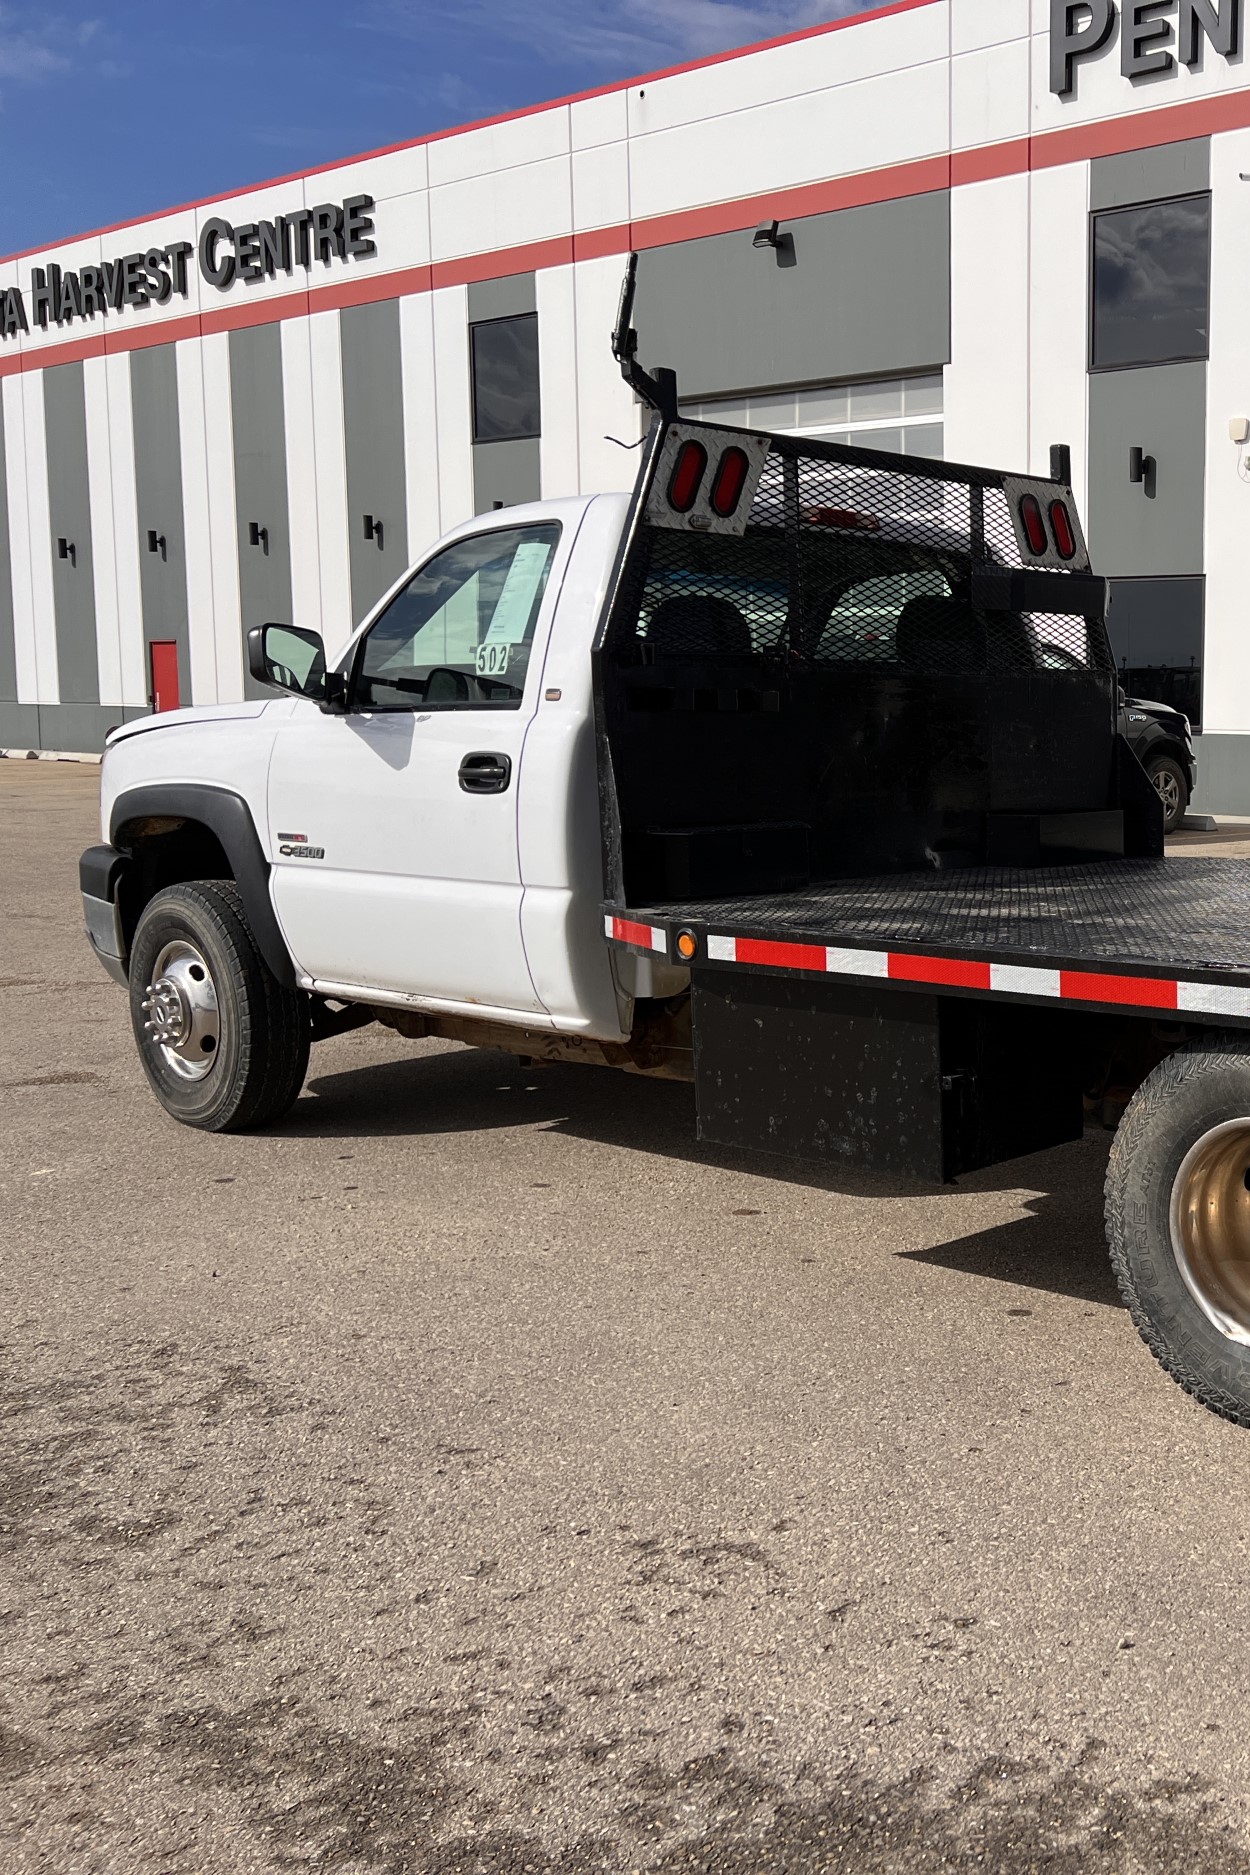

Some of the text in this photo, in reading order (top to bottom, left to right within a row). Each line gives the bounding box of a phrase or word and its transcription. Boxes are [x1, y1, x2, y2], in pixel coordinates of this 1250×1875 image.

[0, 194, 373, 335] A HARVEST CENTRE
[478, 646, 507, 673] 502
[293, 846, 323, 858] 3500
